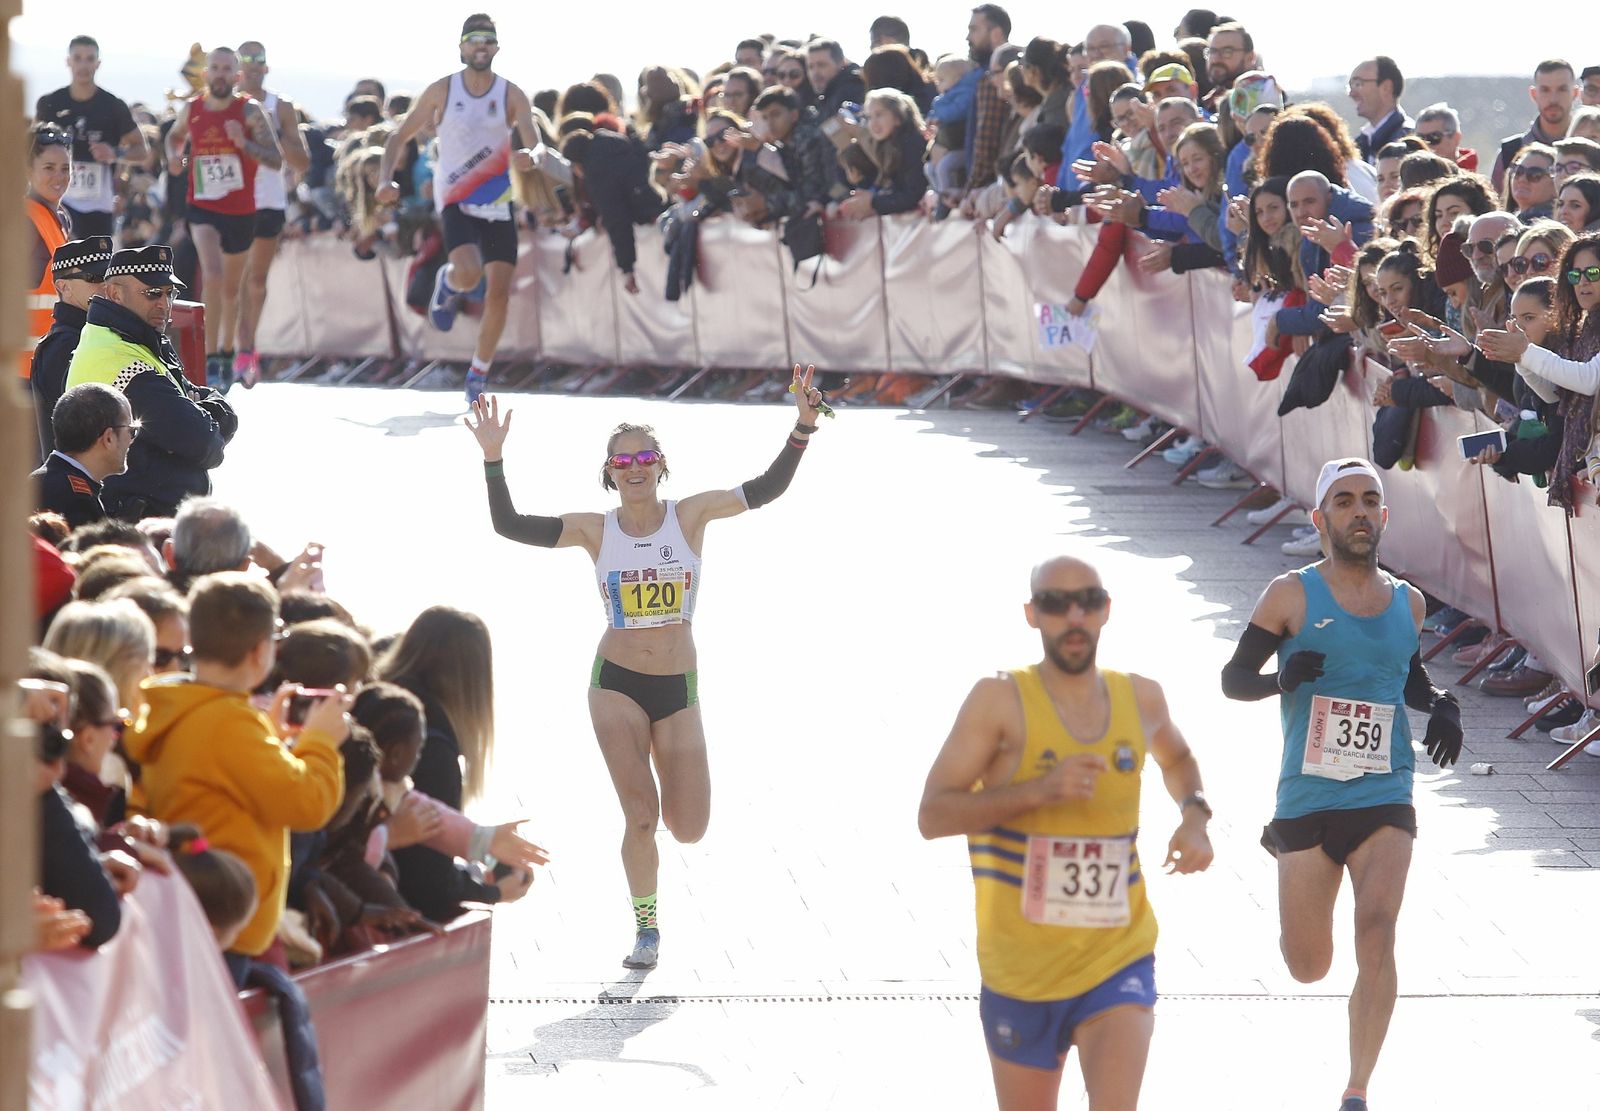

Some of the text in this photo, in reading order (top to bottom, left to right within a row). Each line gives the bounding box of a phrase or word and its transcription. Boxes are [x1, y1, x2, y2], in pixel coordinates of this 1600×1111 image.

[207, 165, 234, 180] 534
[631, 582, 676, 609] 120
[1336, 719, 1382, 752] 359
[1324, 747, 1342, 756] DAVID
[1366, 753, 1389, 762] MORENO
[1062, 862, 1120, 898] 337
